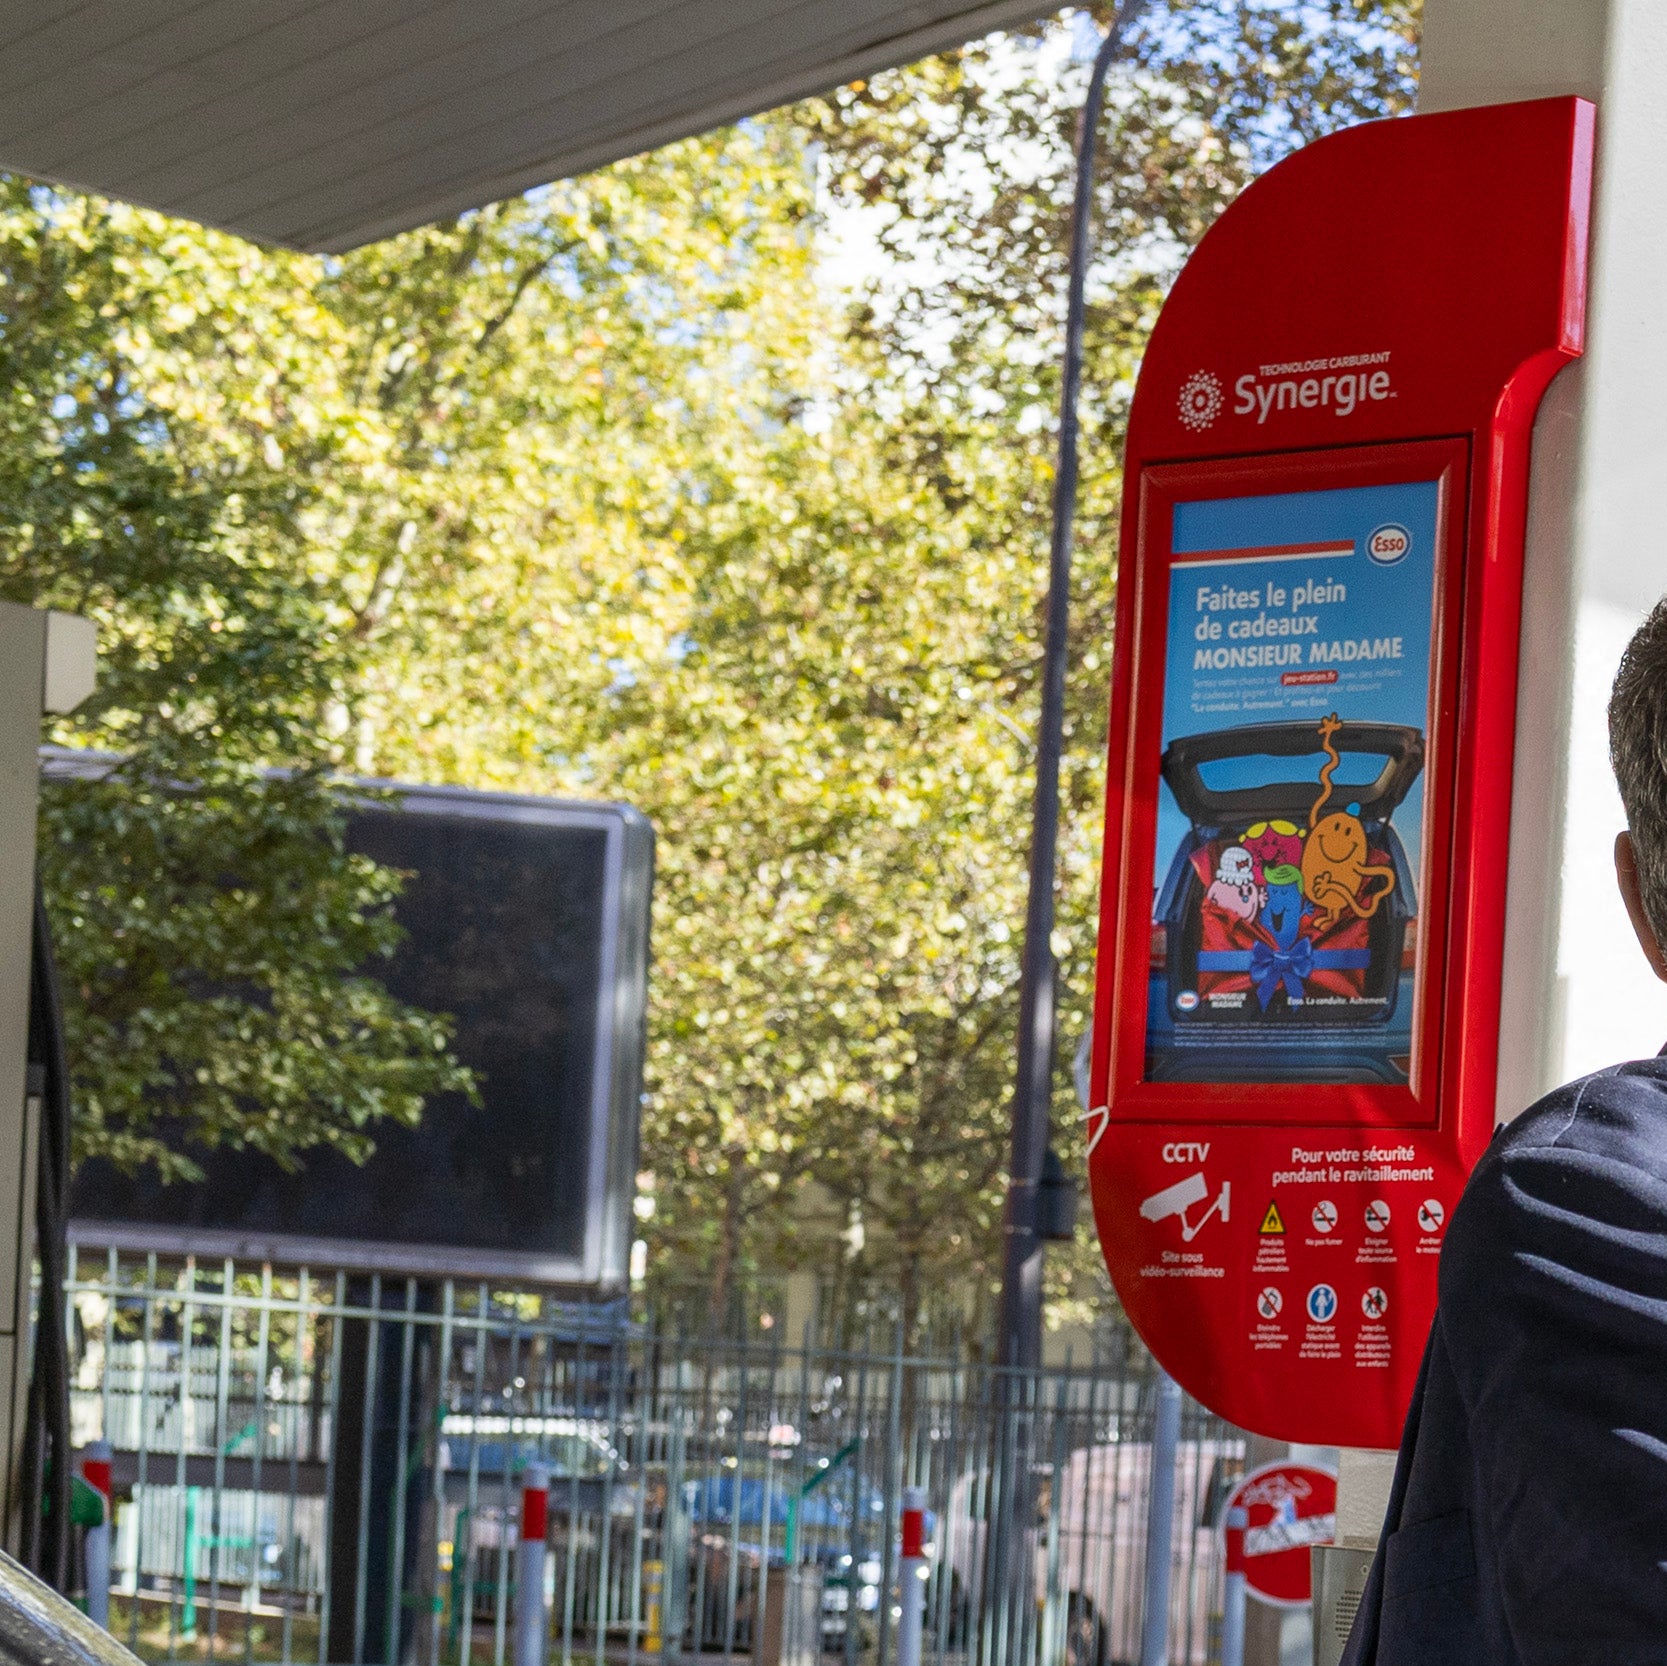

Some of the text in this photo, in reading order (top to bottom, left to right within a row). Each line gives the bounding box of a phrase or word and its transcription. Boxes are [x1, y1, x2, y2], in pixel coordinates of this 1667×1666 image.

[1259, 351, 1391, 377] TECHNOLOGIE CARBURANT
[1234, 370, 1390, 425] Synergie
[1374, 535, 1404, 553] Esso
[1196, 577, 1346, 613] Faites le plein
[1194, 611, 1319, 641] de cadeaux
[1193, 637, 1403, 670] MONSIEUR MADAME
[1162, 1143, 1210, 1163] CCTV
[1291, 1145, 1415, 1163] Pour votre sécurité
[1272, 1166, 1434, 1187] pendant le ravitaillement
[1314, 1239, 1325, 1247] pas
[1325, 1238, 1343, 1246] fumer
[1161, 1251, 1204, 1263] Site sous
[1140, 1265, 1225, 1278] vidéo-surveillance
